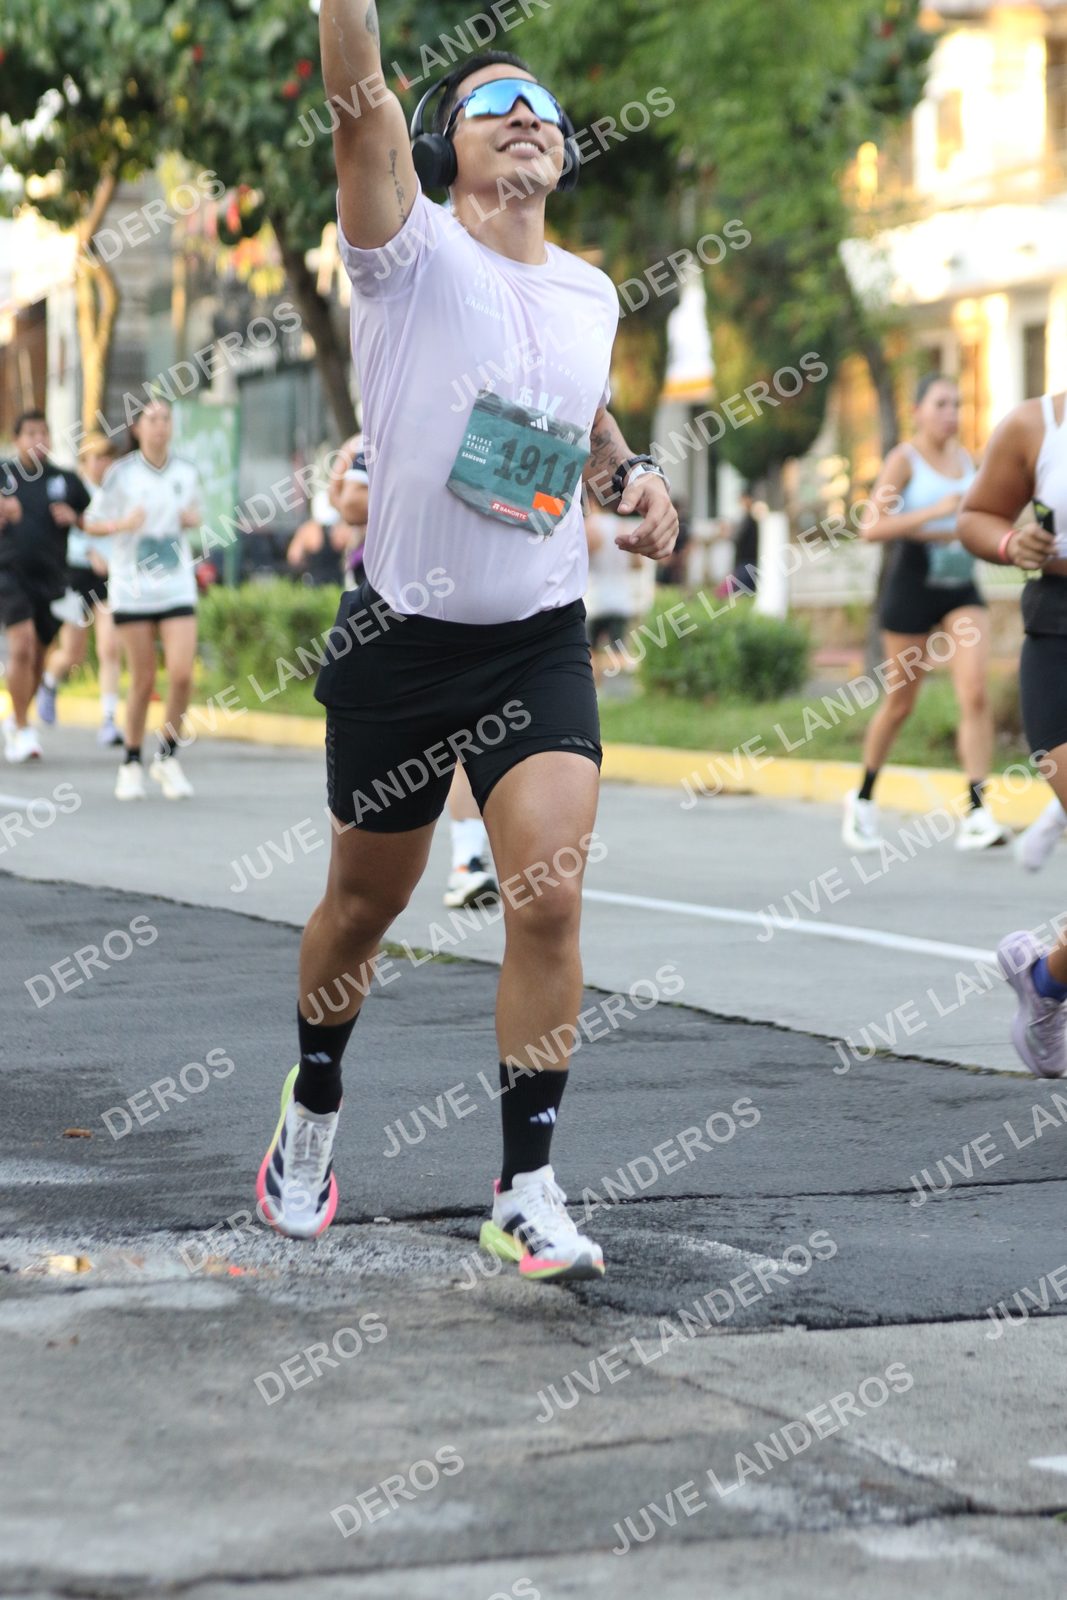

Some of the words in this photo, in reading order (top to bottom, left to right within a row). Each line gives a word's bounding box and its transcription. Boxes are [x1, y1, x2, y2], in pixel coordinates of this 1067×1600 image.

[461, 451, 487, 465] SAMSUNG
[493, 438, 578, 497] 1911
[499, 506, 528, 520] BANORTE
